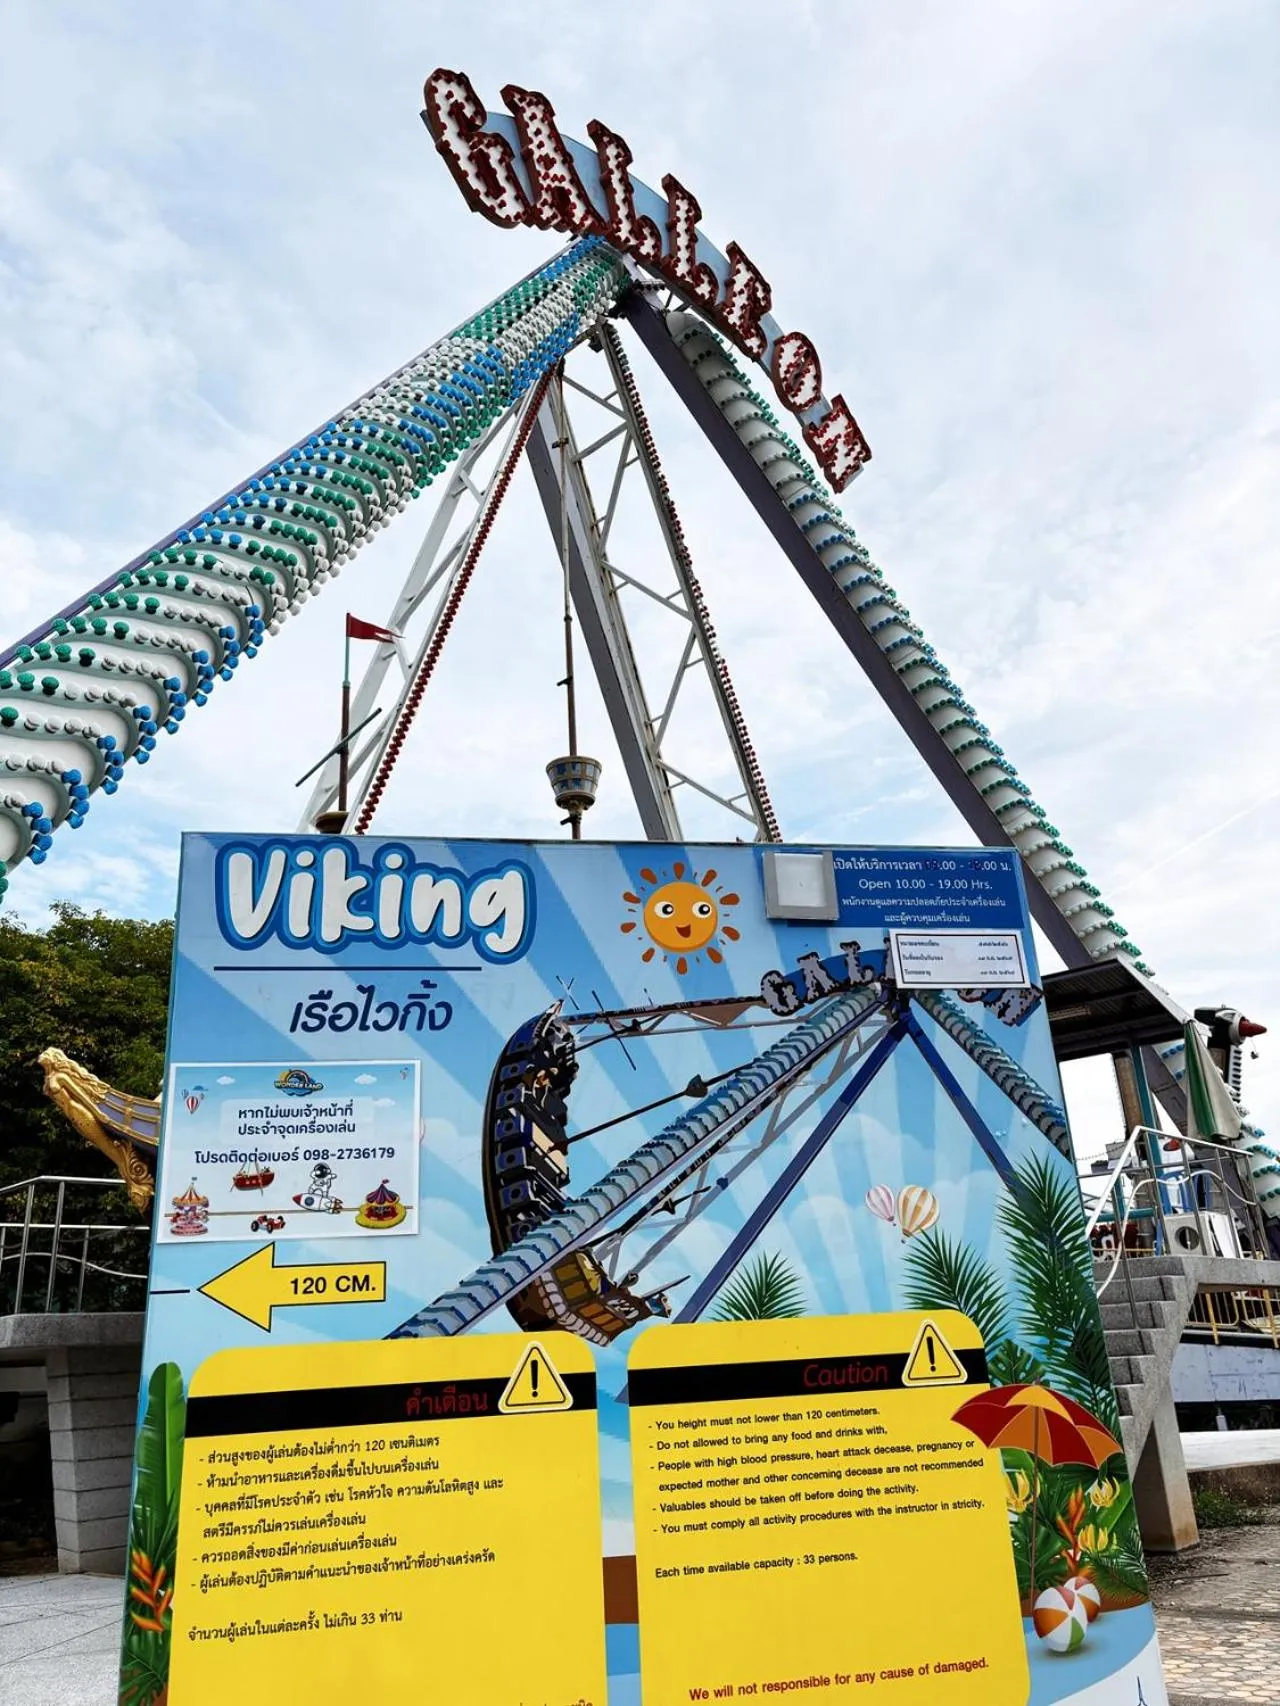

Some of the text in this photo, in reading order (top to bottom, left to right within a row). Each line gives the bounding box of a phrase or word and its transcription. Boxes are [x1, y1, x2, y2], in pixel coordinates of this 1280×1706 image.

[423, 67, 873, 494] GALLEON
[858, 879, 891, 891] Open
[895, 879, 926, 889] 10.00
[938, 879, 968, 889] 19.00
[971, 879, 993, 889] Hrs.
[225, 846, 528, 955] Viking
[289, 980, 453, 1033] เรือไวกิ้ง
[238, 1099, 354, 1119] หากไม่พบเจ้าหน้าที่
[238, 1117, 356, 1139] ประจำจุดเครื่องเล่น
[194, 1146, 395, 1164] โปรดติดต่อเบอร์ 098-2736179
[290, 1274, 376, 1295] 120 CM.
[803, 1361, 889, 1387] Caution
[655, 1421, 675, 1430] You
[677, 1418, 707, 1430] height
[710, 1417, 733, 1426] must
[736, 1415, 752, 1424] not
[754, 1414, 780, 1423] lower
[782, 1412, 803, 1421] than
[806, 1410, 823, 1420] 120
[366, 1439, 386, 1452] 120
[656, 1441, 671, 1451] Do
[673, 1440, 690, 1449] not
[692, 1436, 729, 1448] allowed
[731, 1436, 742, 1445] to
[744, 1435, 769, 1445] bring
[772, 1434, 788, 1443] any
[791, 1430, 812, 1441] food
[815, 1429, 833, 1439] and
[835, 1427, 863, 1438] drinks
[658, 1460, 691, 1472] People
[694, 1458, 714, 1468] with
[717, 1456, 738, 1468] high
[740, 1453, 767, 1464] blood
[770, 1452, 814, 1464] pressure,
[816, 1449, 840, 1459] heart
[843, 1446, 871, 1457] attack
[916, 1442, 963, 1454] pregnancy
[965, 1440, 975, 1448] or
[659, 1479, 703, 1493] expected
[706, 1477, 740, 1488] mother
[743, 1474, 761, 1485] and
[763, 1474, 788, 1483] other
[844, 1467, 883, 1477] decease
[886, 1466, 901, 1474] are
[903, 1463, 918, 1472] not
[921, 1457, 984, 1471] recommended
[659, 1500, 707, 1513] Valuables
[709, 1497, 741, 1509] should
[744, 1496, 757, 1506] be
[759, 1494, 786, 1504] taken
[788, 1492, 801, 1502] off
[804, 1490, 834, 1501] before
[837, 1488, 864, 1499] doing
[866, 1486, 881, 1496] the
[884, 1484, 919, 1495] activity.
[661, 1524, 680, 1534] You
[683, 1521, 708, 1532] must
[710, 1518, 746, 1530] comply
[748, 1516, 760, 1527] all
[763, 1513, 797, 1525] activity
[800, 1510, 853, 1524] procedures
[855, 1507, 875, 1518] with
[877, 1506, 892, 1516] the
[895, 1503, 938, 1514] instructor
[941, 1501, 949, 1510] in
[655, 1567, 680, 1578] Each
[683, 1565, 705, 1576] time
[708, 1560, 750, 1573] available
[753, 1557, 794, 1570] capacity
[803, 1554, 815, 1565] 33
[818, 1552, 858, 1565] persons.
[361, 1612, 376, 1625] 33
[689, 1657, 989, 1701] We will not responsible for any cause of damaged.
